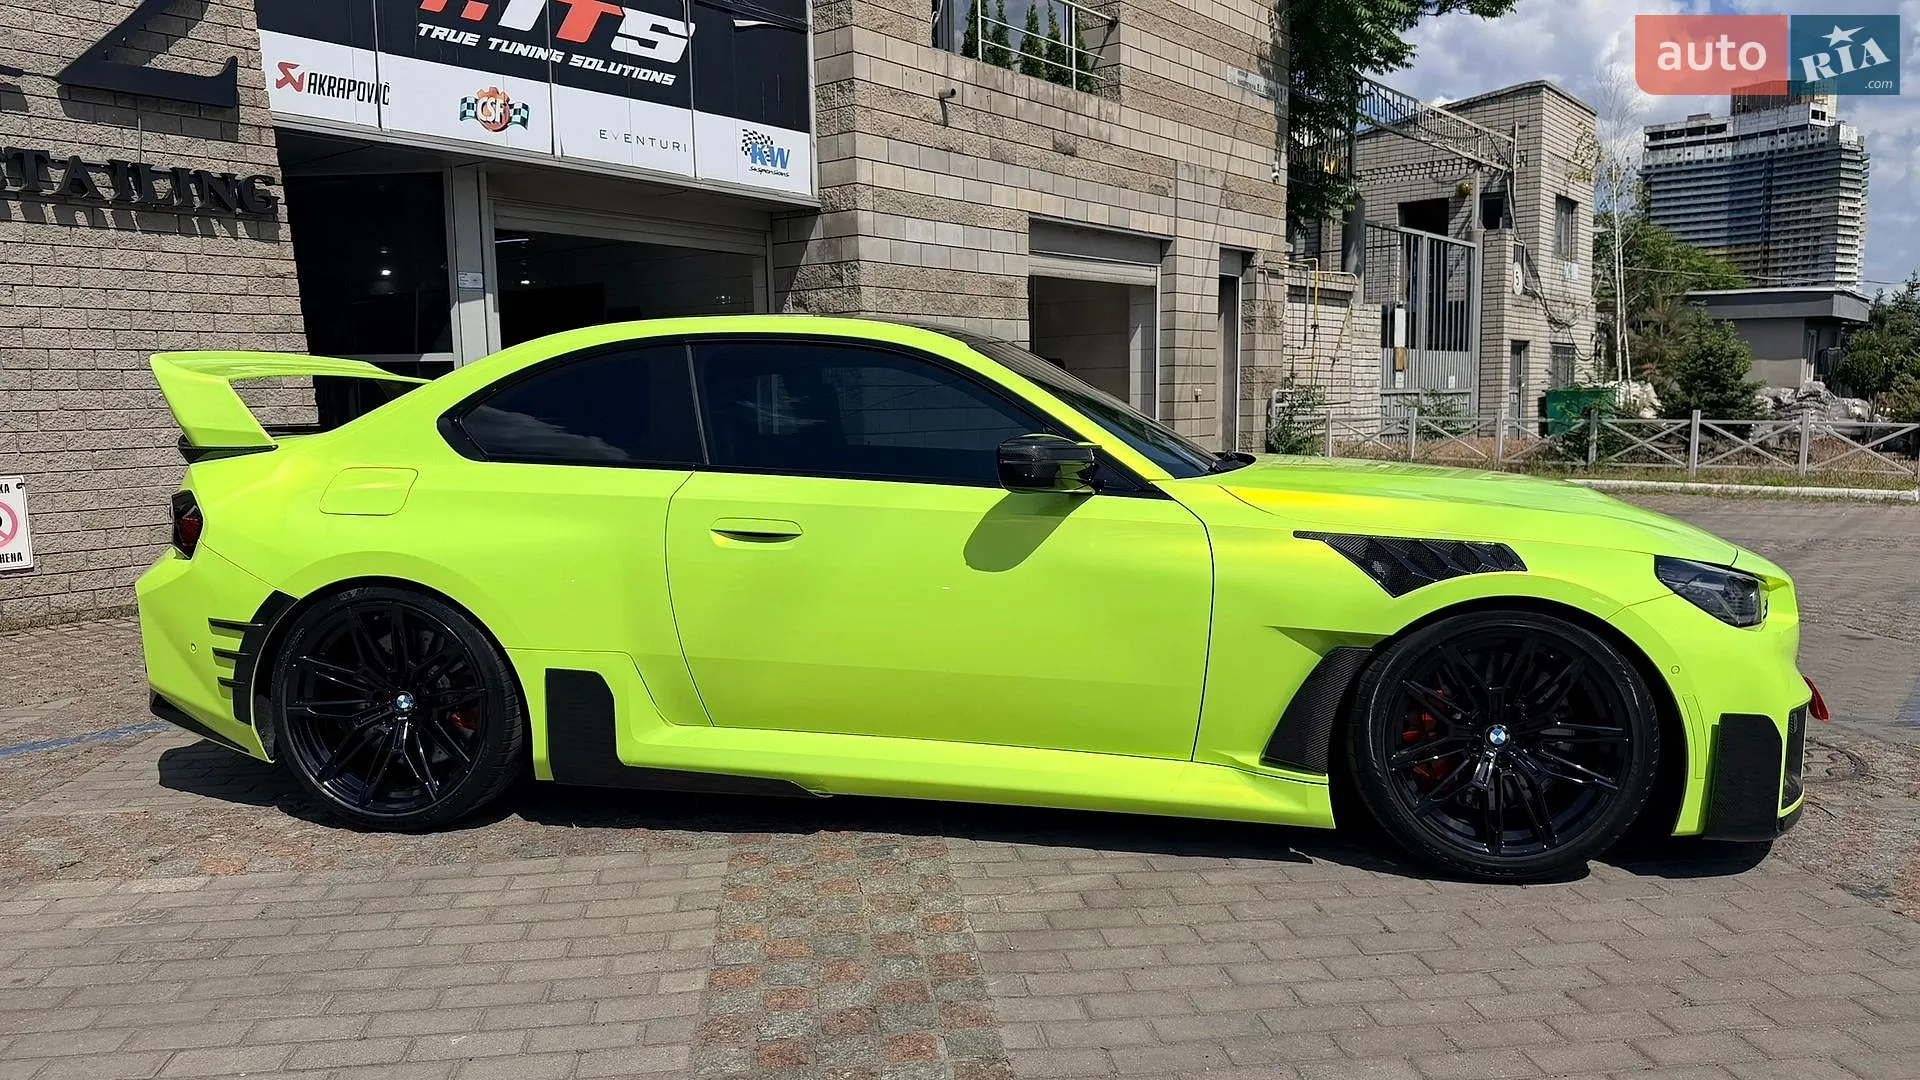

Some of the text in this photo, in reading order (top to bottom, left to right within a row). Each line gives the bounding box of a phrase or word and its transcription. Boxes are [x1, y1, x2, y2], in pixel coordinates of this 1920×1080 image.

[417, 22, 678, 86] TRUE TUNING SOLUTIONS
[476, 96, 506, 124] CSF
[599, 128, 688, 153] EVENTURI
[750, 141, 791, 170] KW
[0, 146, 280, 214] TAILING
